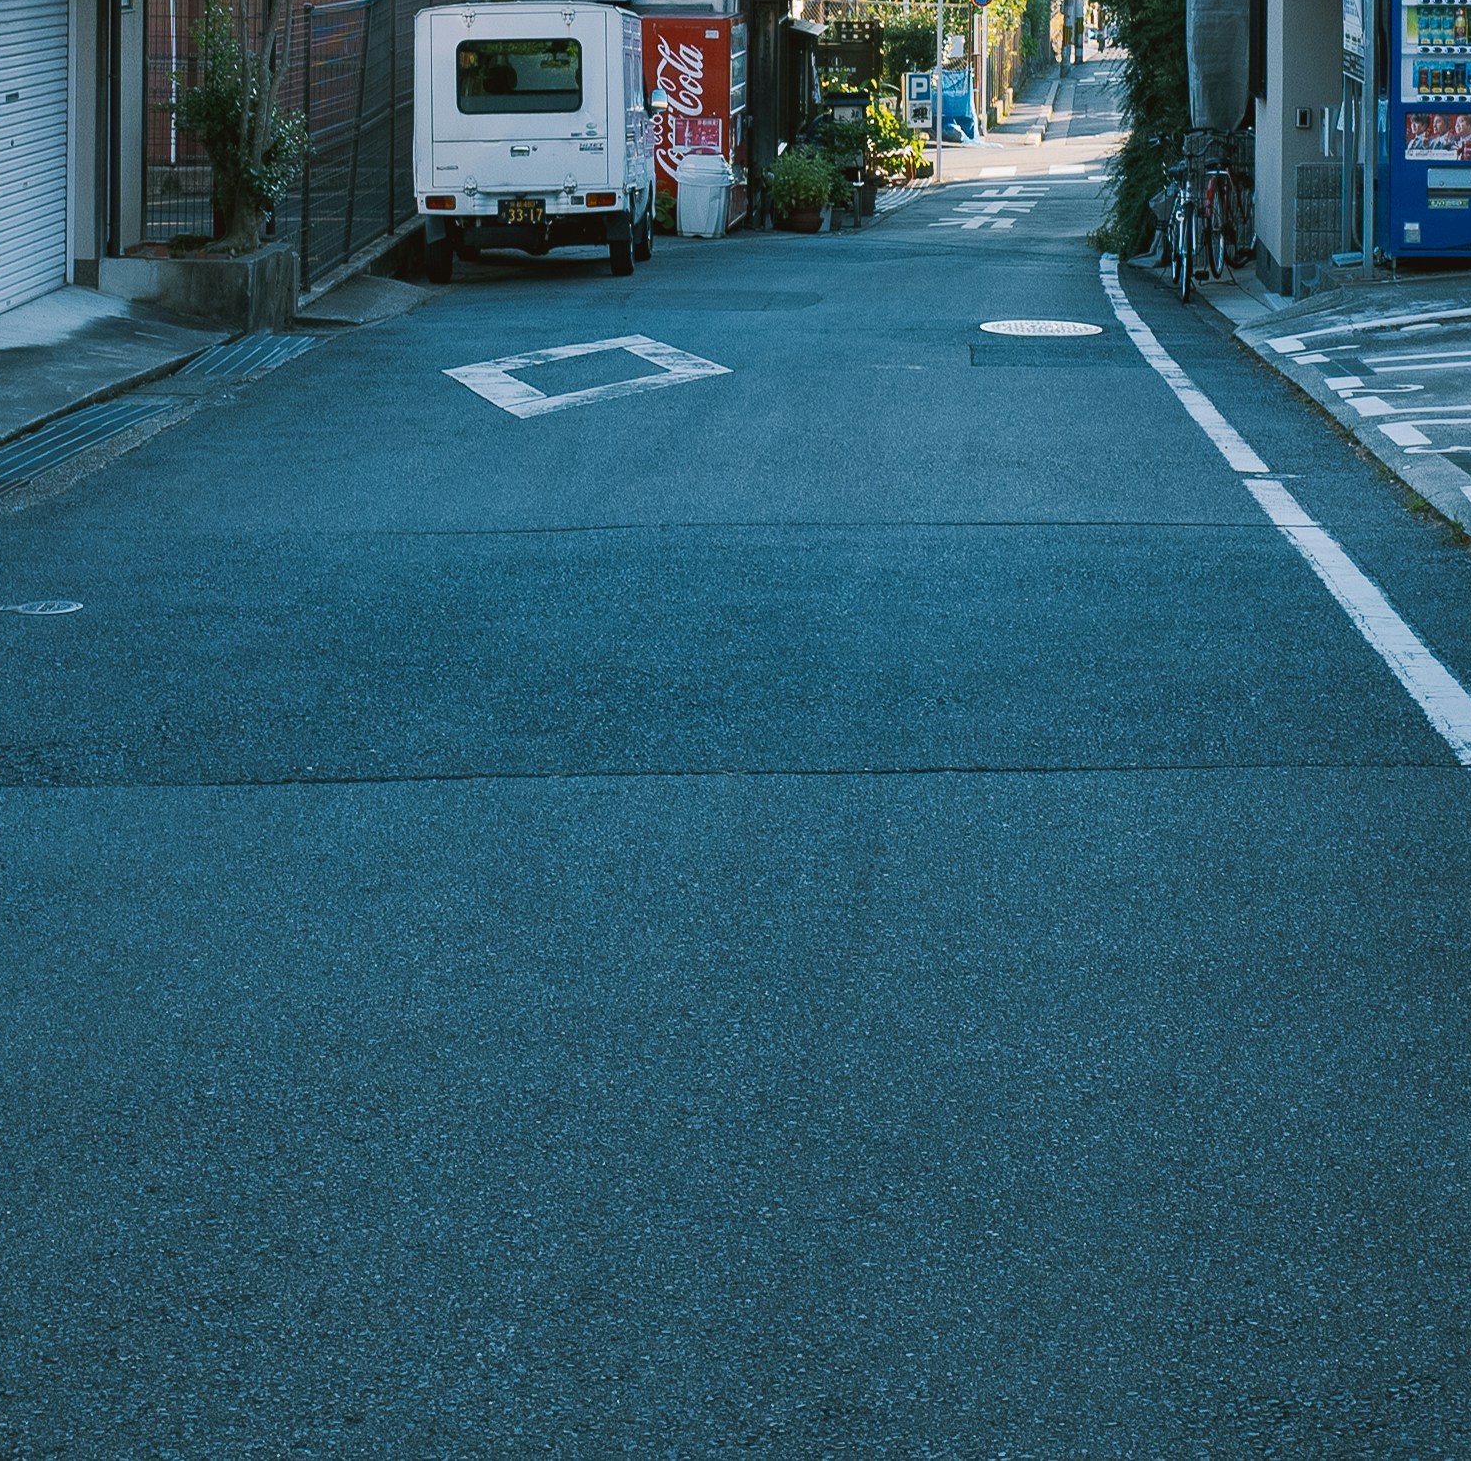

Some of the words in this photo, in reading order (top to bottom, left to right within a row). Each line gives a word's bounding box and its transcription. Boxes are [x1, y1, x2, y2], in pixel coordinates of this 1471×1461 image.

[911, 77, 928, 100] P
[656, 33, 704, 183] Co-Cola
[508, 208, 544, 222] 33-17
[928, 186, 1050, 230] 止まれ
